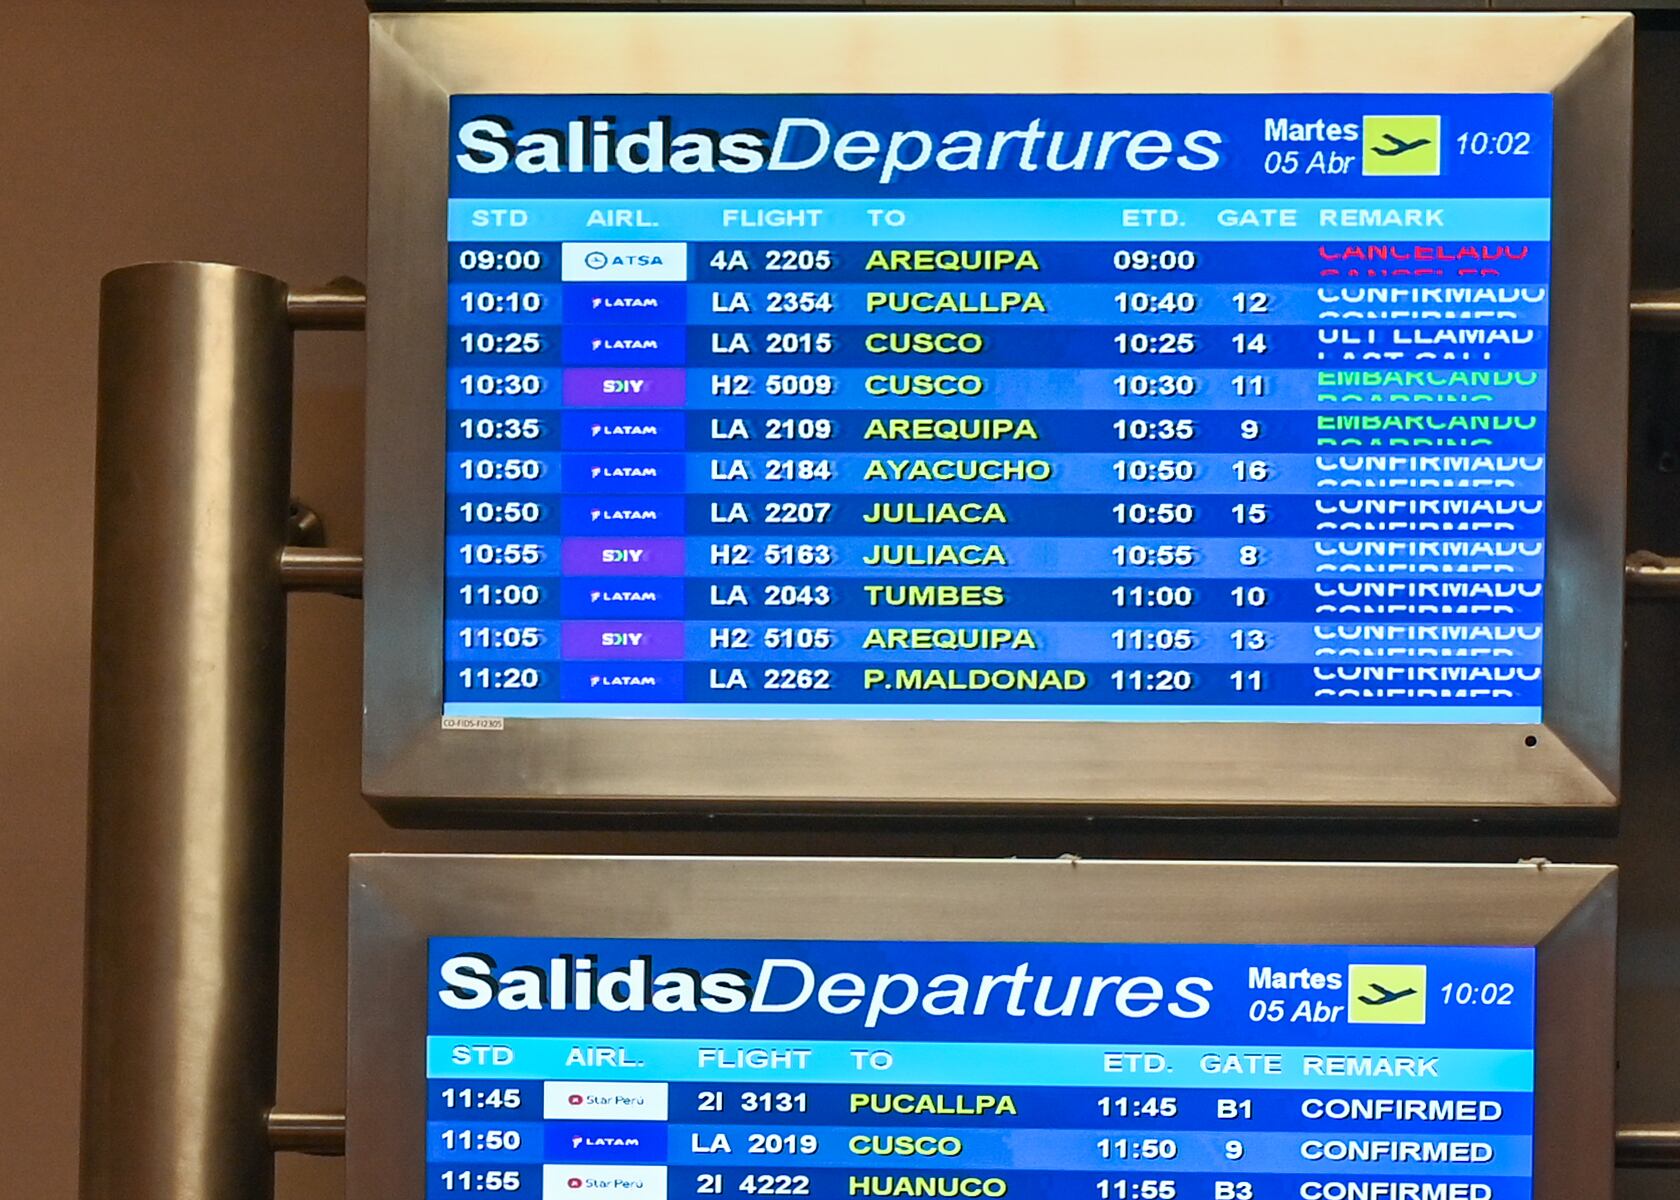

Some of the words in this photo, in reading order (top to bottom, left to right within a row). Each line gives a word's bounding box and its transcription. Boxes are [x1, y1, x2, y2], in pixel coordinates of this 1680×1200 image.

[1265, 118, 1358, 141] Martes
[1458, 132, 1530, 154] 10:02
[1265, 151, 1298, 174] 05
[1305, 151, 1355, 174] Abr
[472, 210, 528, 227] STD
[587, 210, 658, 226] AIRL.
[724, 210, 823, 226] FLIGHT
[868, 210, 906, 226] TO
[1123, 209, 1185, 227] ETD.
[1218, 209, 1296, 226] GATE
[1320, 209, 1443, 226] REMARK
[460, 250, 539, 269] 09:00
[612, 256, 663, 266] ATSA
[710, 250, 748, 270] 4A
[766, 250, 830, 270] 2205
[866, 250, 1038, 270] AREQUIPA
[1114, 251, 1194, 270] 09:00
[460, 668, 538, 688] 11:20
[603, 677, 655, 685] LATAM
[710, 669, 747, 688] LA
[764, 669, 829, 689] 2262
[865, 670, 1085, 689] P.MALDONAD
[1112, 670, 1190, 690] 11:20
[1231, 671, 1260, 690] 11
[1249, 967, 1342, 989] Martes
[1442, 983, 1514, 1005] 10:02
[1250, 1000, 1284, 1021] 05
[1290, 1001, 1344, 1022] Abr
[452, 1046, 514, 1065] STD
[566, 1048, 644, 1067] AIRL.
[699, 1050, 811, 1068] FLIGHT
[851, 1052, 893, 1070] TO
[1104, 1054, 1173, 1072] ETD.
[1200, 1056, 1282, 1074] GATE
[1304, 1057, 1438, 1076] REMARK
[442, 1089, 520, 1108] 11:45
[587, 1096, 611, 1104] Star
[742, 1092, 805, 1112] 3131
[851, 1094, 1016, 1114] PUCALLPA
[1098, 1097, 1176, 1116] 11:45
[1218, 1099, 1250, 1118] B1
[1302, 1099, 1501, 1120] CONFIRMED
